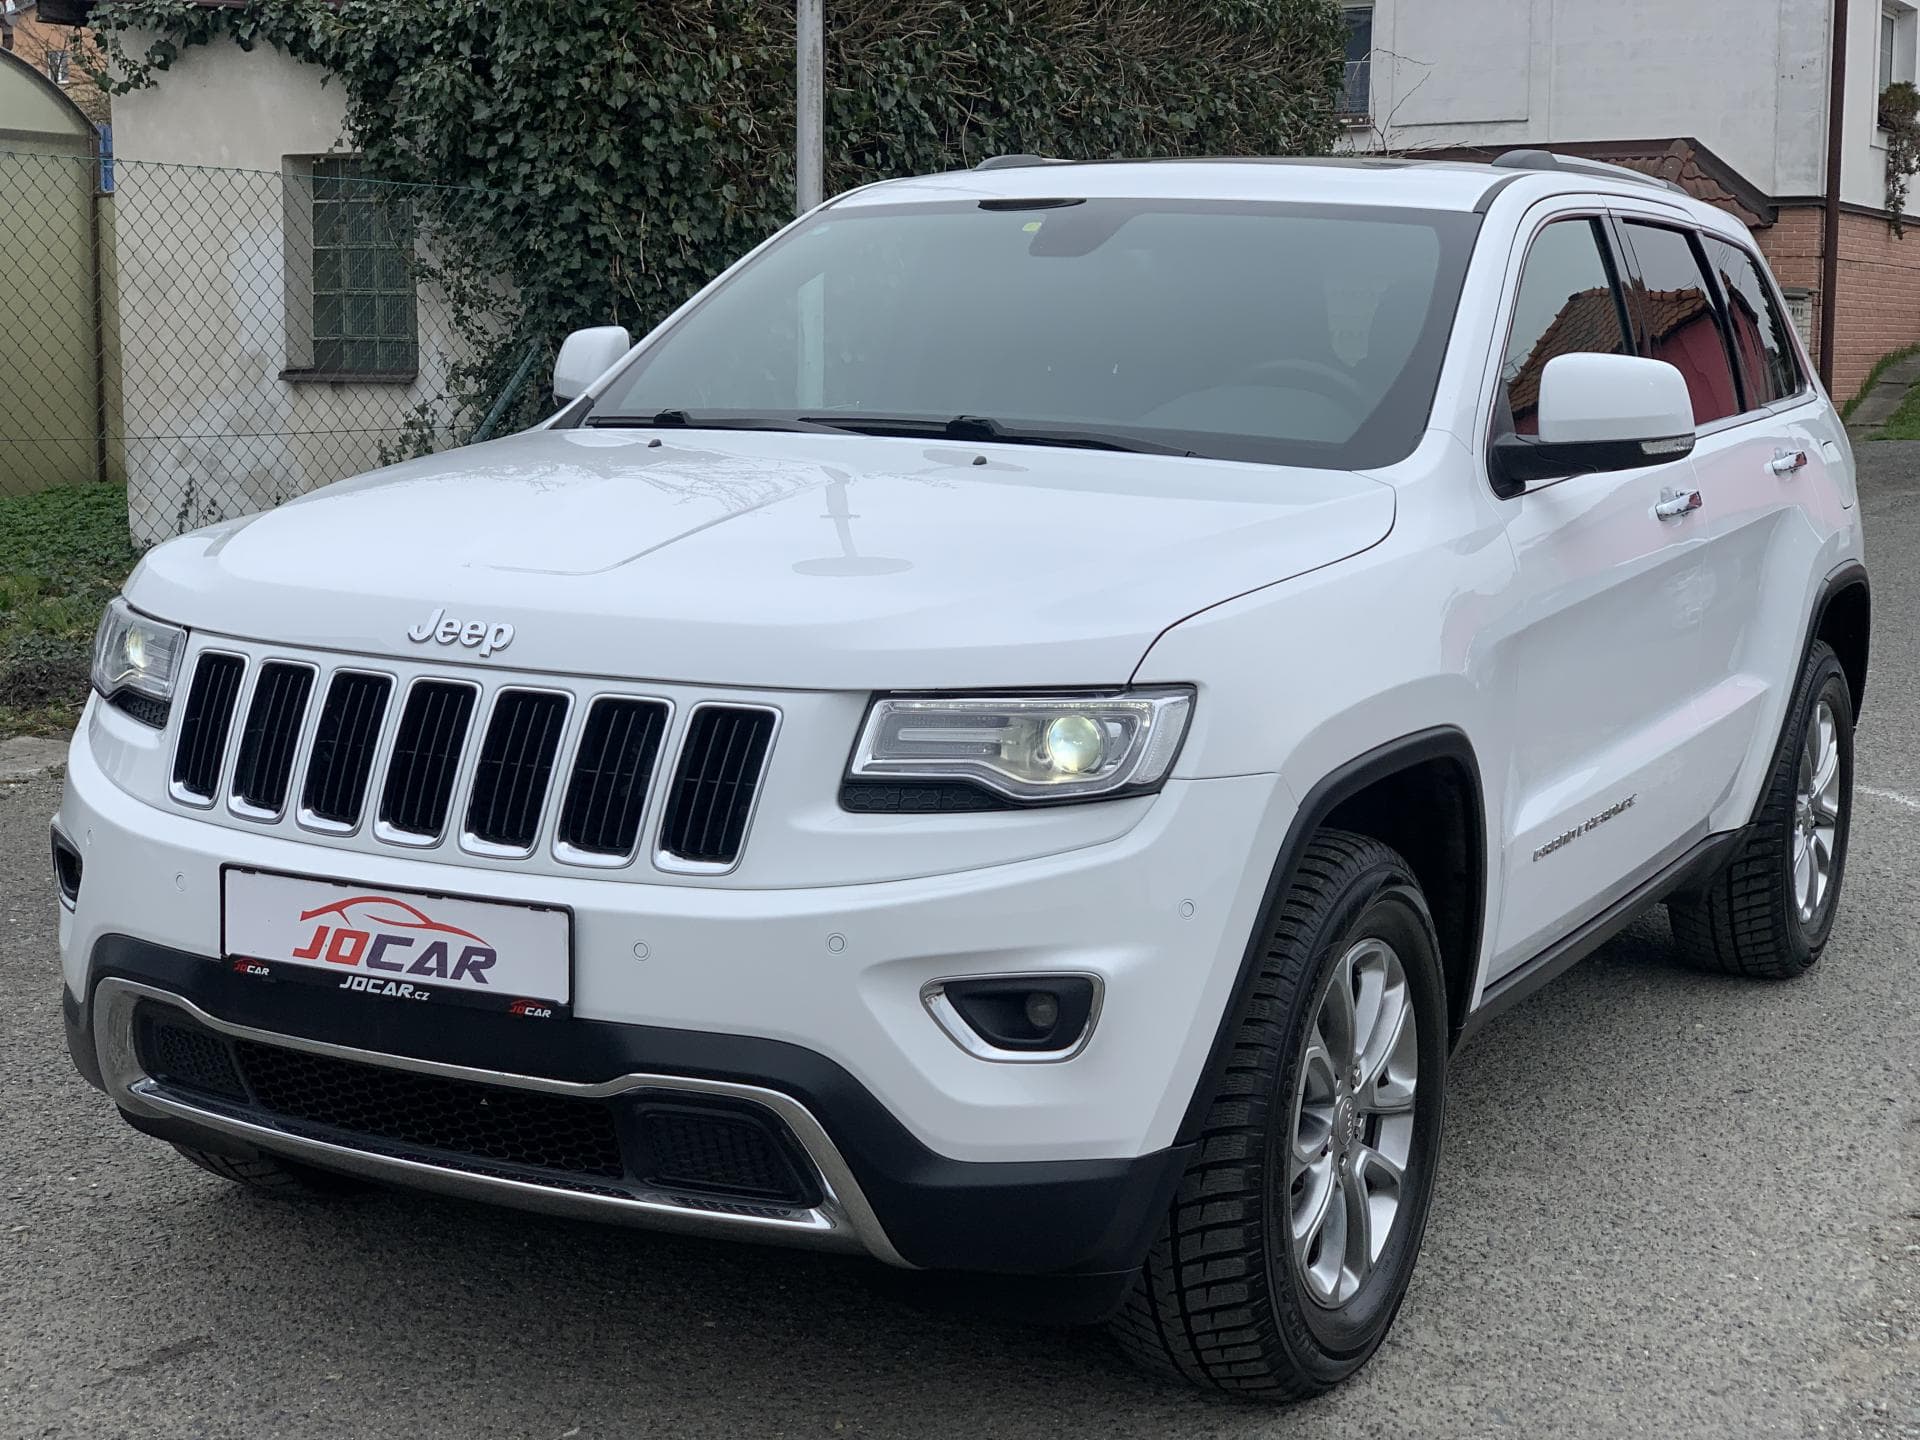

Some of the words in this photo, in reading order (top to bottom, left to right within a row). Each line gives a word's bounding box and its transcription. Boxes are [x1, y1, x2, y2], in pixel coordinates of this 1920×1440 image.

[408, 608, 515, 658] Jeep
[292, 925, 498, 985] JOCAR
[233, 963, 270, 976] JOCAR
[339, 975, 431, 1001] JOCAR.cz
[509, 1005, 552, 1018] JOCAR
